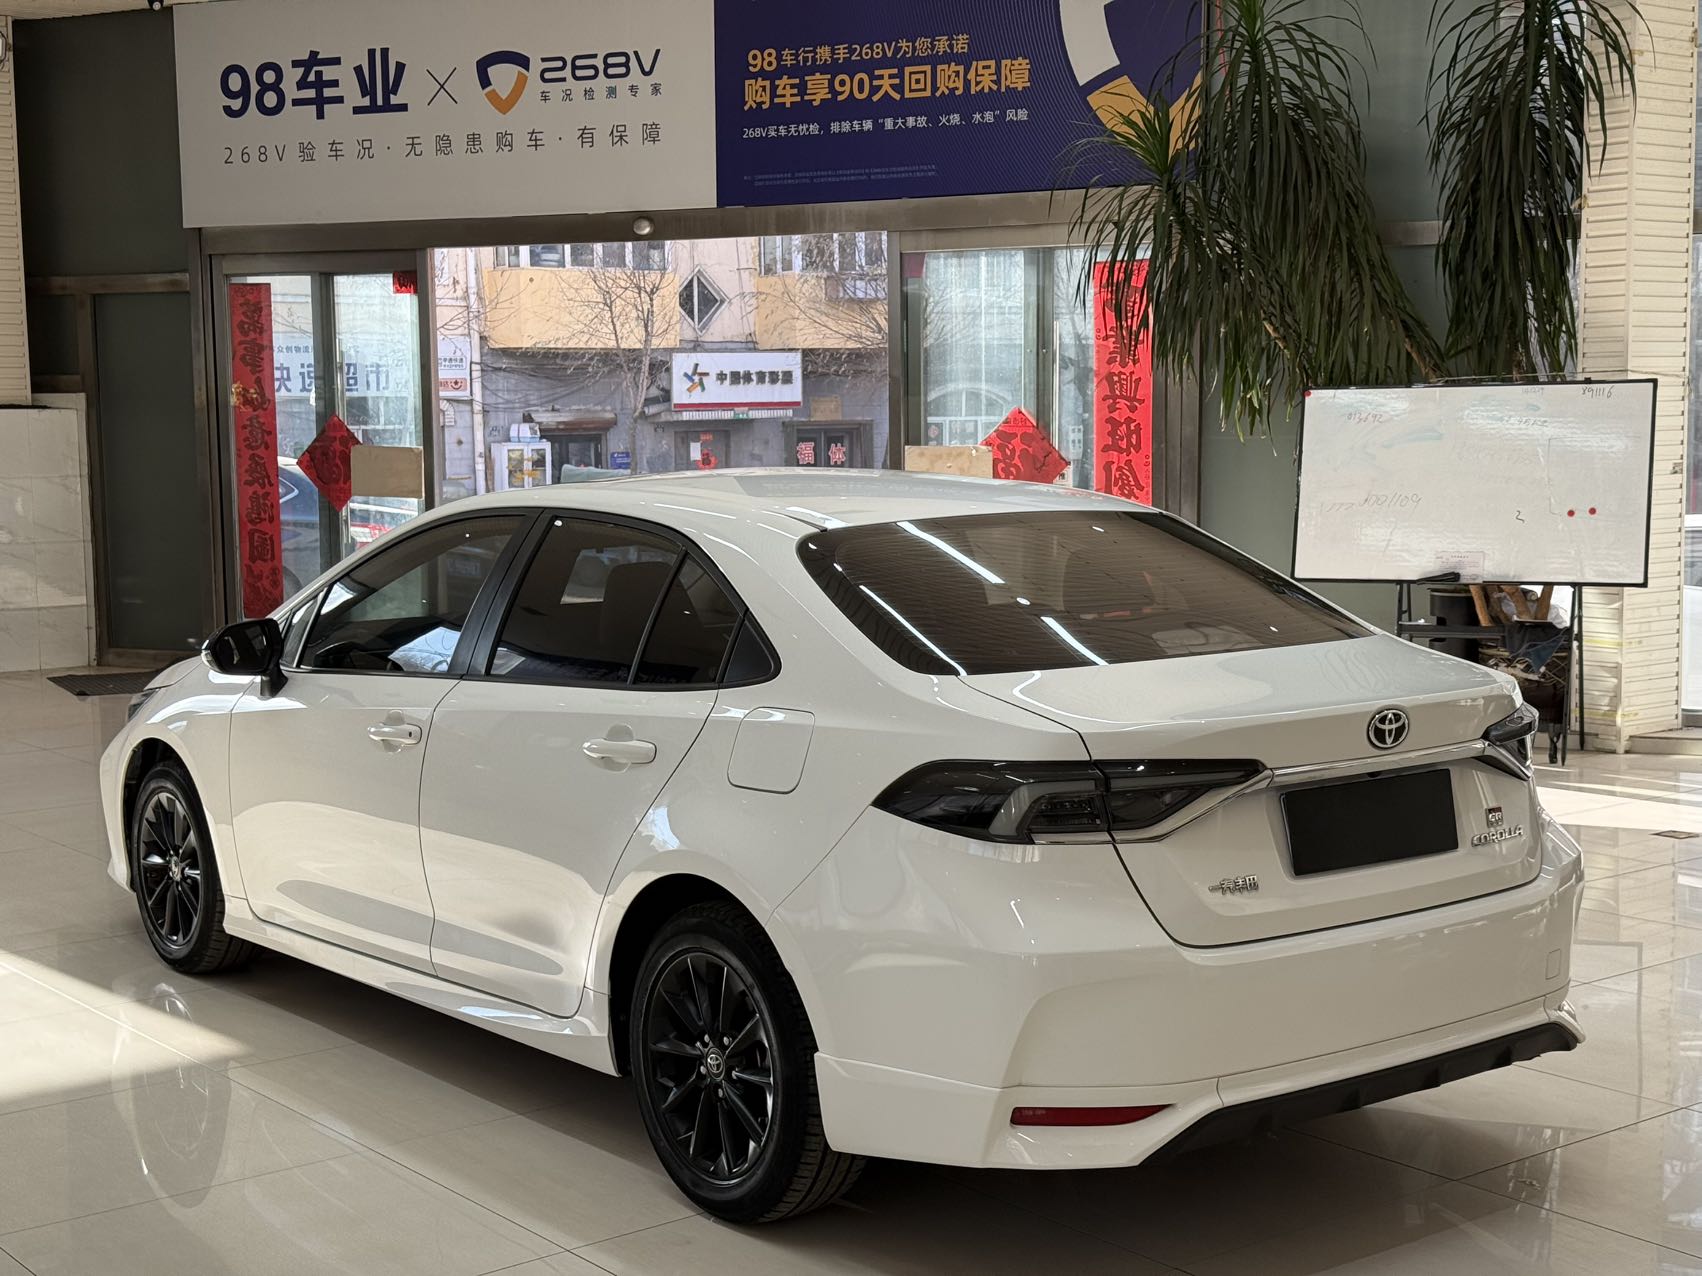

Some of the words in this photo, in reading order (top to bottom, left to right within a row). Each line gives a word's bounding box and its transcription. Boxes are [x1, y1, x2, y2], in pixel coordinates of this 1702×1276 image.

[539, 48, 661, 84] 268V
[220, 47, 409, 120] 98车业
[539, 82, 662, 104] 车况检测专家
[743, 57, 1032, 111] 购车享90天回购保障
[715, 370, 793, 386] 中国体育彩票
[796, 441, 815, 465] 福
[829, 443, 846, 465] 体
[1471, 824, 1524, 847] COROLLA
